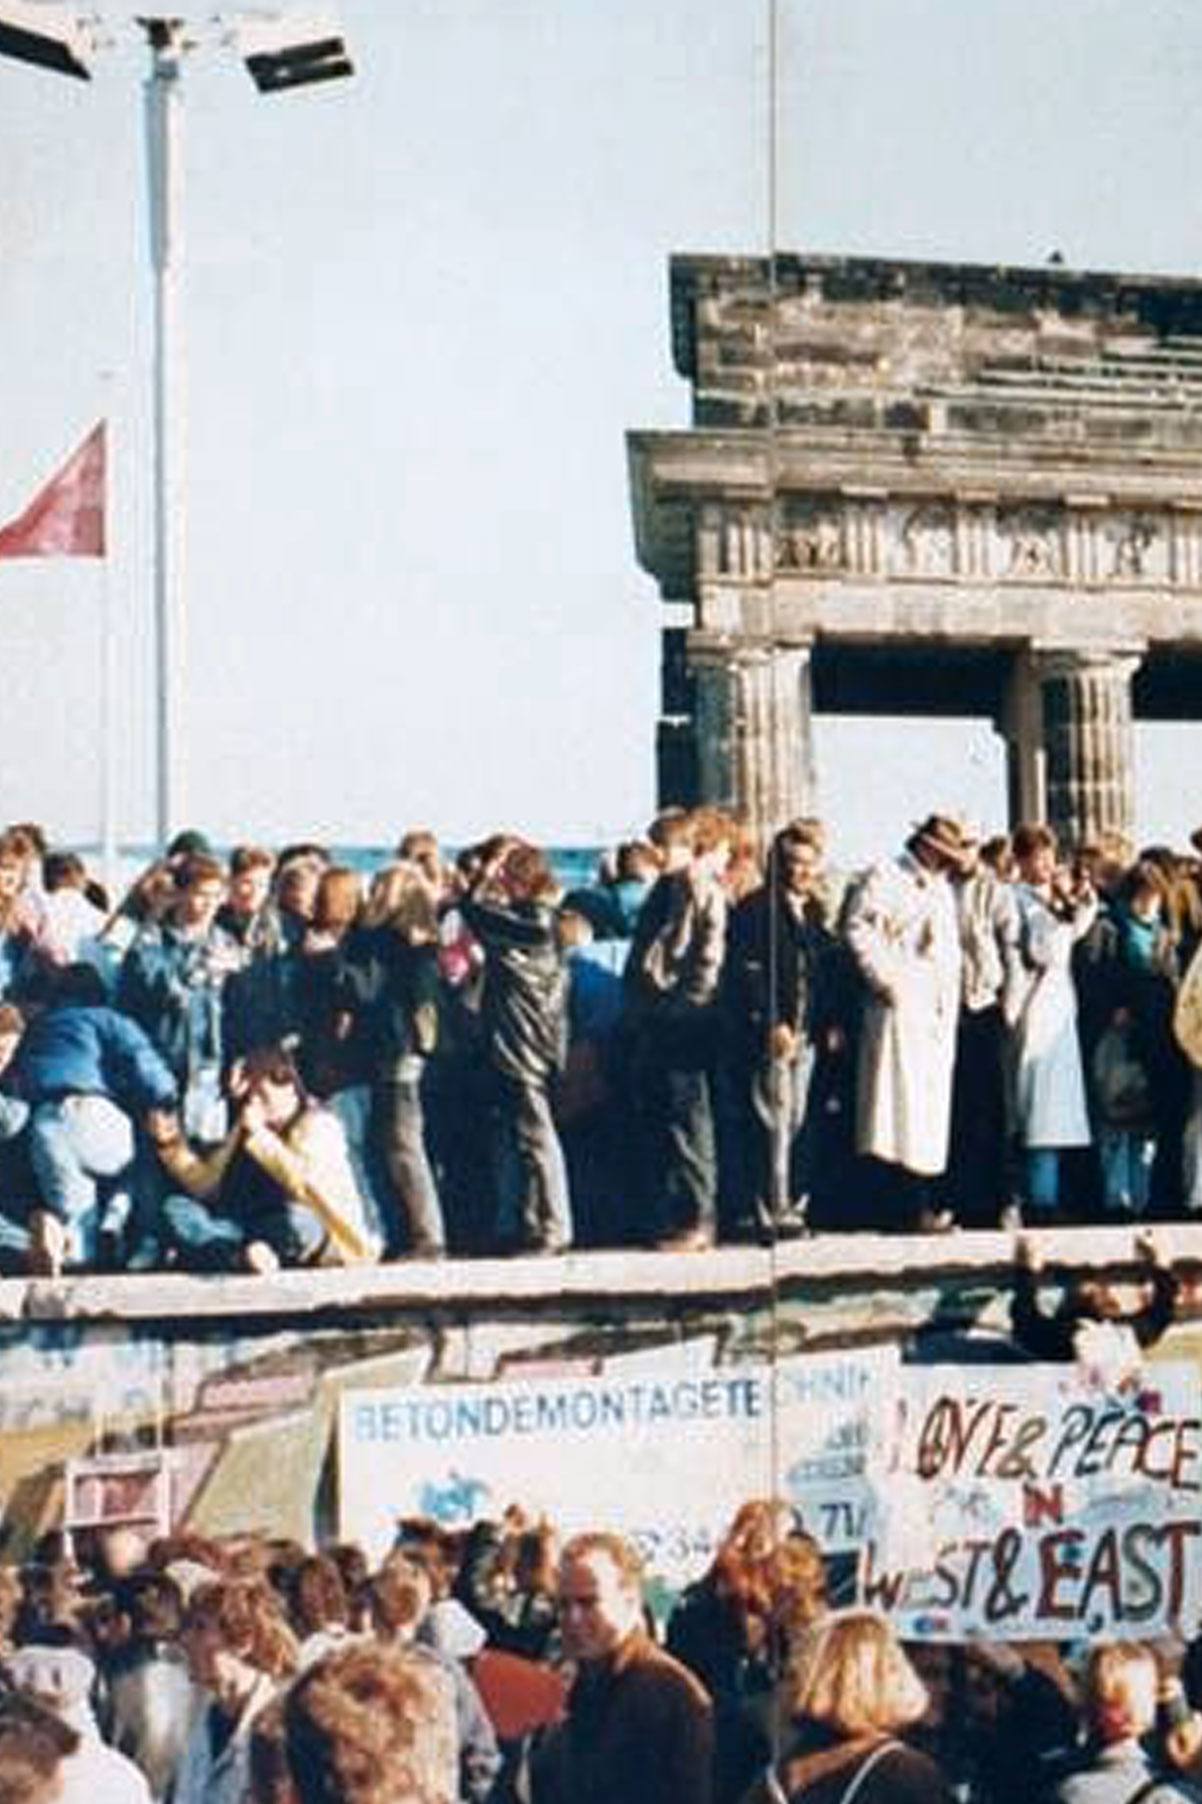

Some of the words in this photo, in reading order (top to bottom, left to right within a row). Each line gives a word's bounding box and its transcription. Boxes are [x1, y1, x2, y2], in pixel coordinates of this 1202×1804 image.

[1047, 1404, 1202, 1490] PEACE
[1021, 1483, 1065, 1527] IN
[984, 1527, 1029, 1623] &
[1034, 1520, 1202, 1625] EAST
